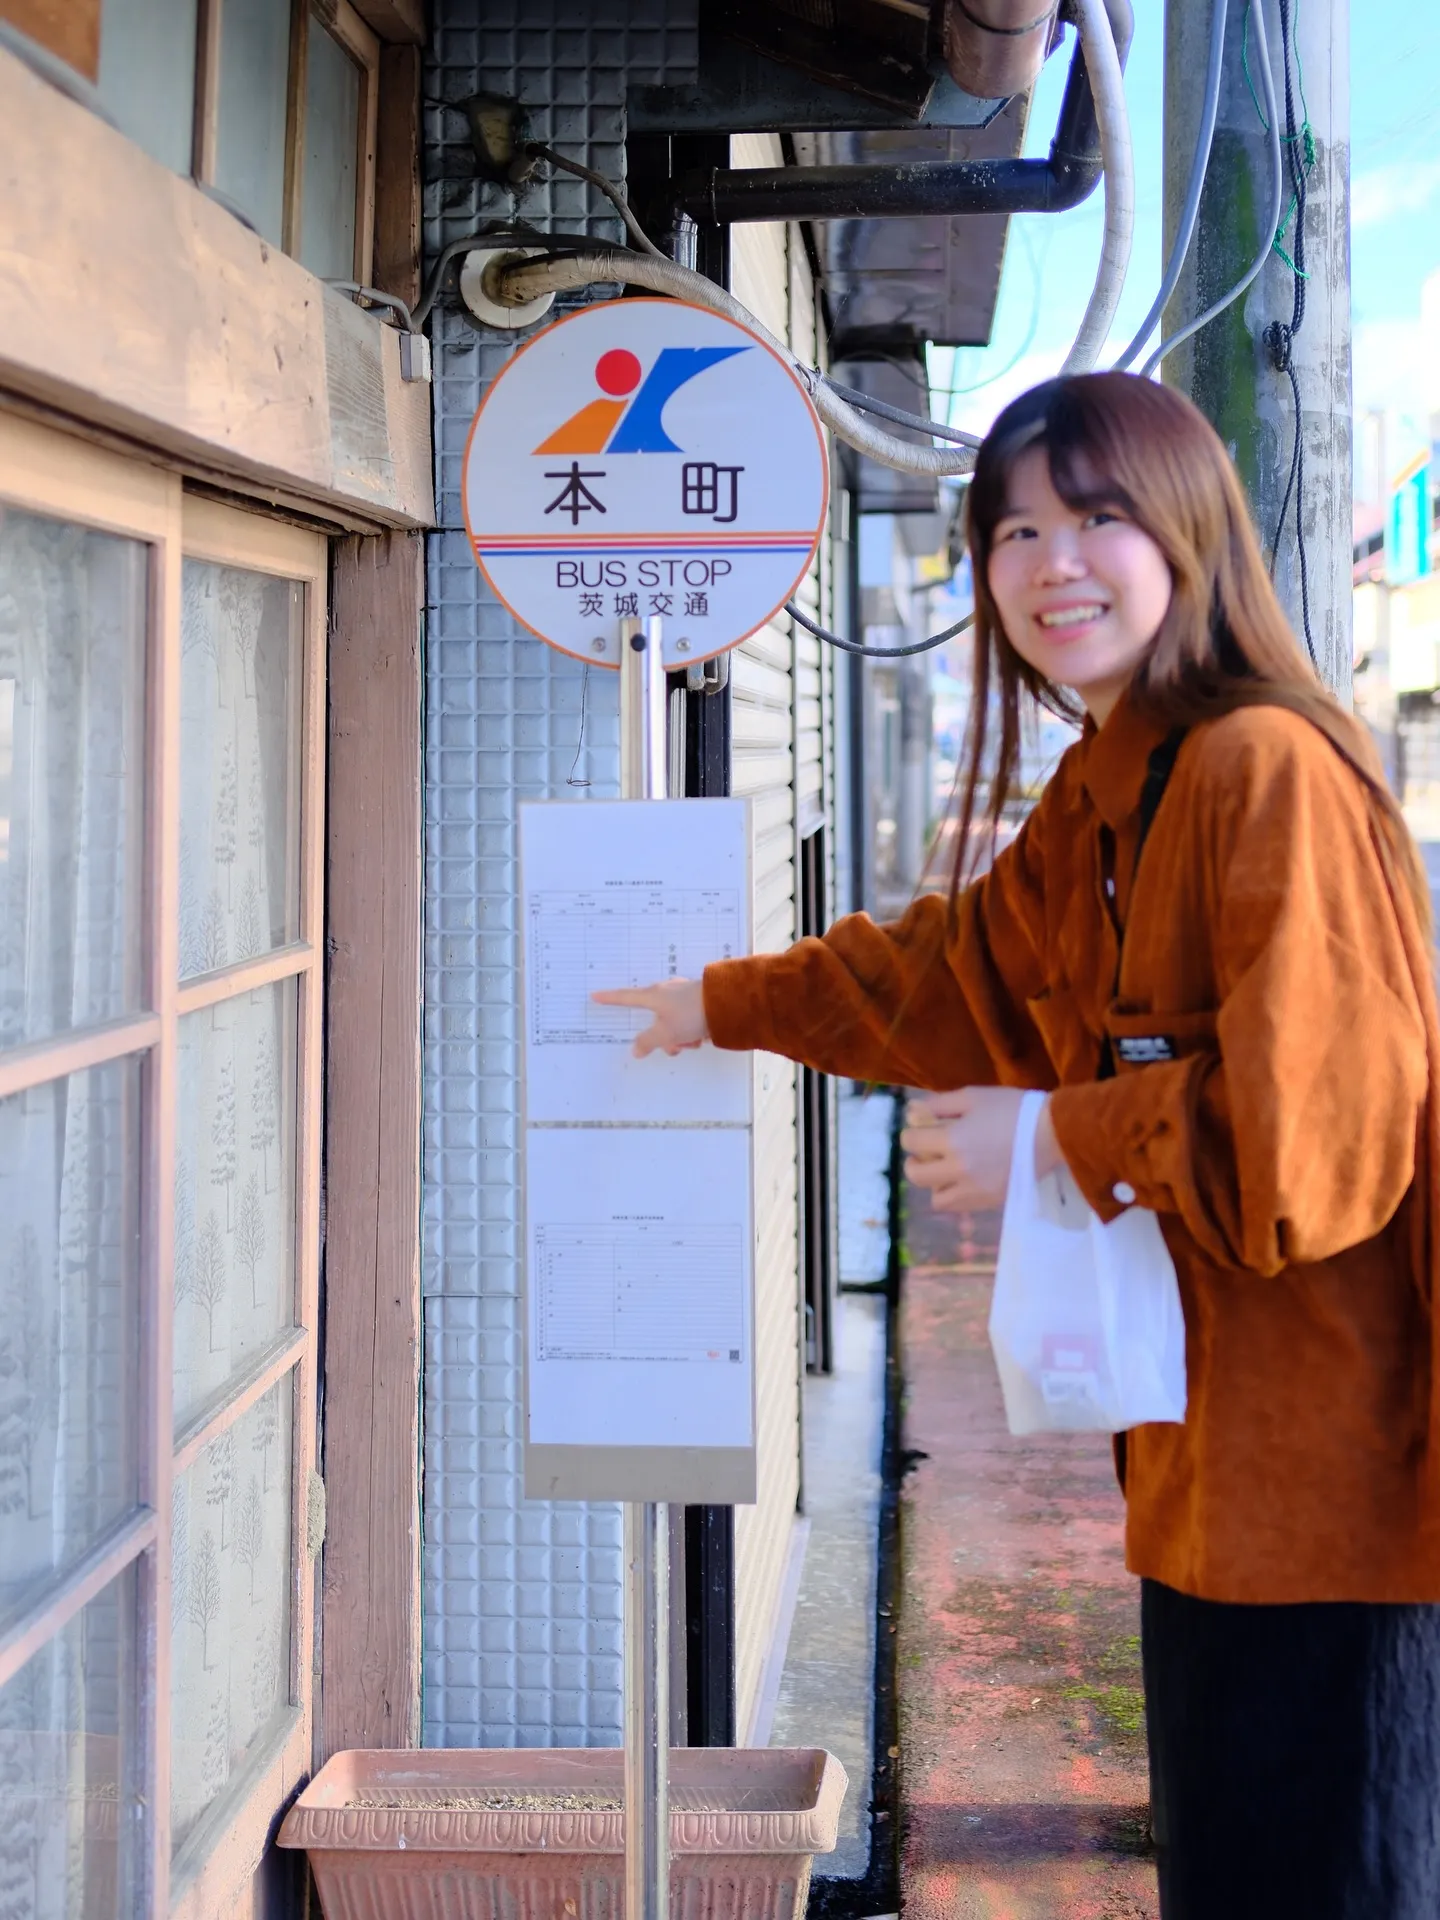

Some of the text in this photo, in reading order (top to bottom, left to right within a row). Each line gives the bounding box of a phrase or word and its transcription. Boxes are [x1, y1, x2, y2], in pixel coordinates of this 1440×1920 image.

[543, 461, 745, 525] 本町
[556, 559, 733, 588] BUS STOP
[578, 591, 709, 617] 茨城交通
